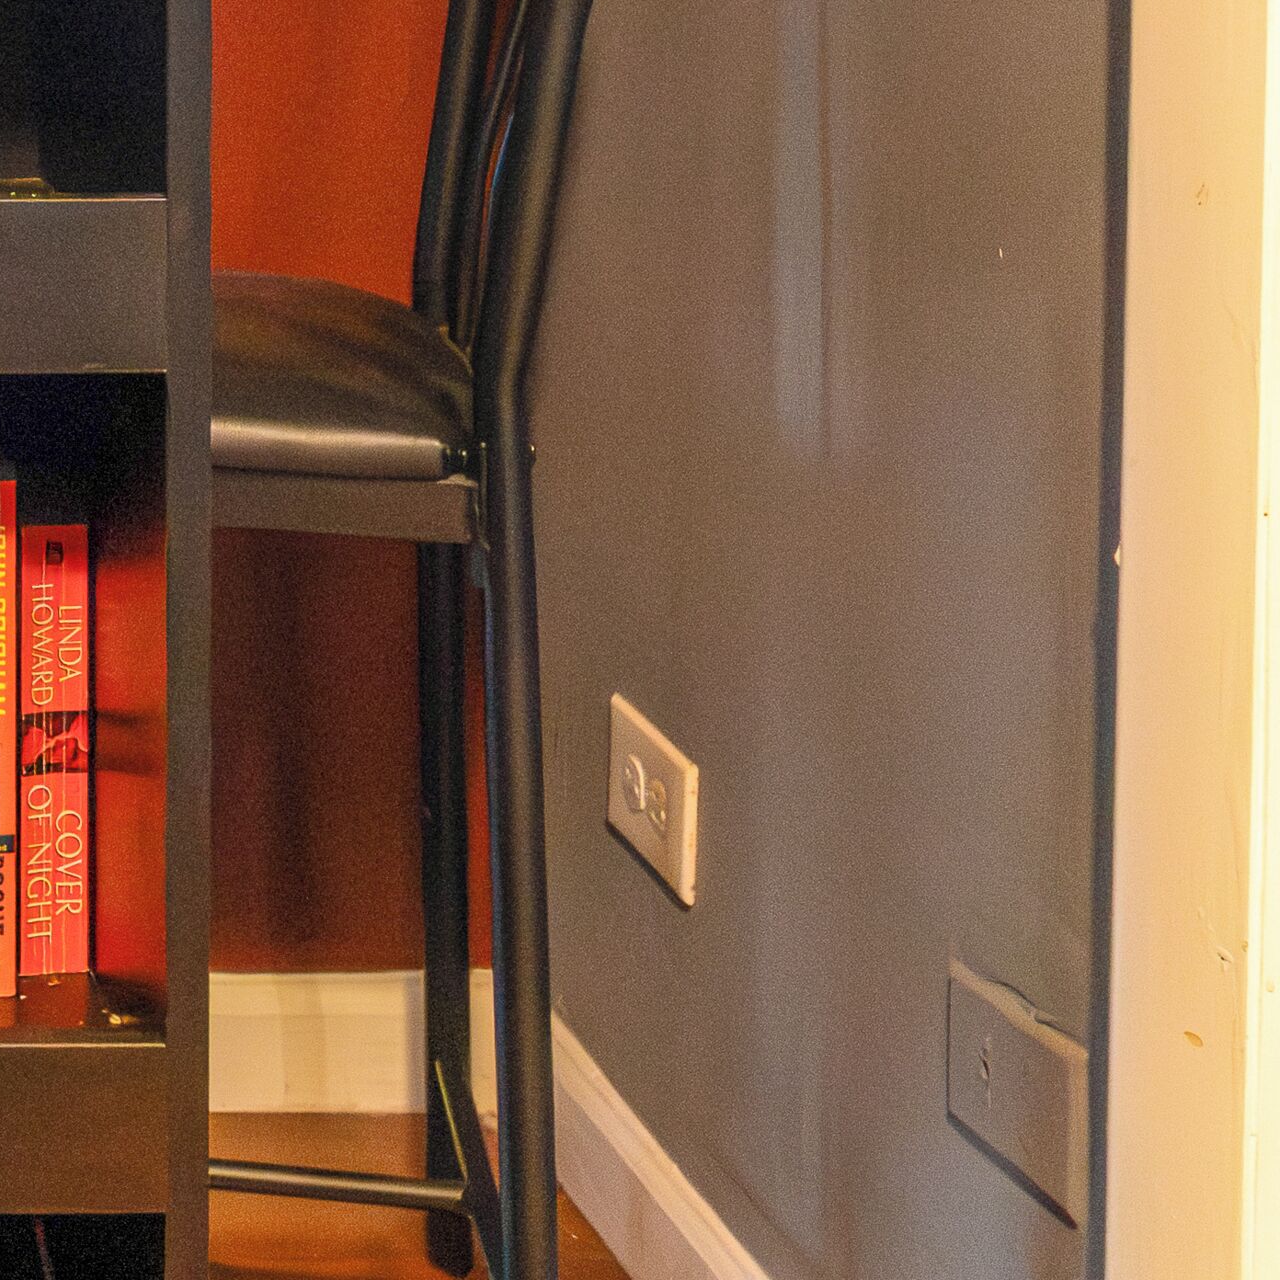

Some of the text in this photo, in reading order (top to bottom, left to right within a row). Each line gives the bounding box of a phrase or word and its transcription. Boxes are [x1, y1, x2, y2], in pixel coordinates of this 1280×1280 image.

[31, 584, 56, 706] HOWARD
[58, 604, 84, 682] LINDA
[25, 784, 55, 946] OF NIGHT
[54, 810, 83, 914] COVER
